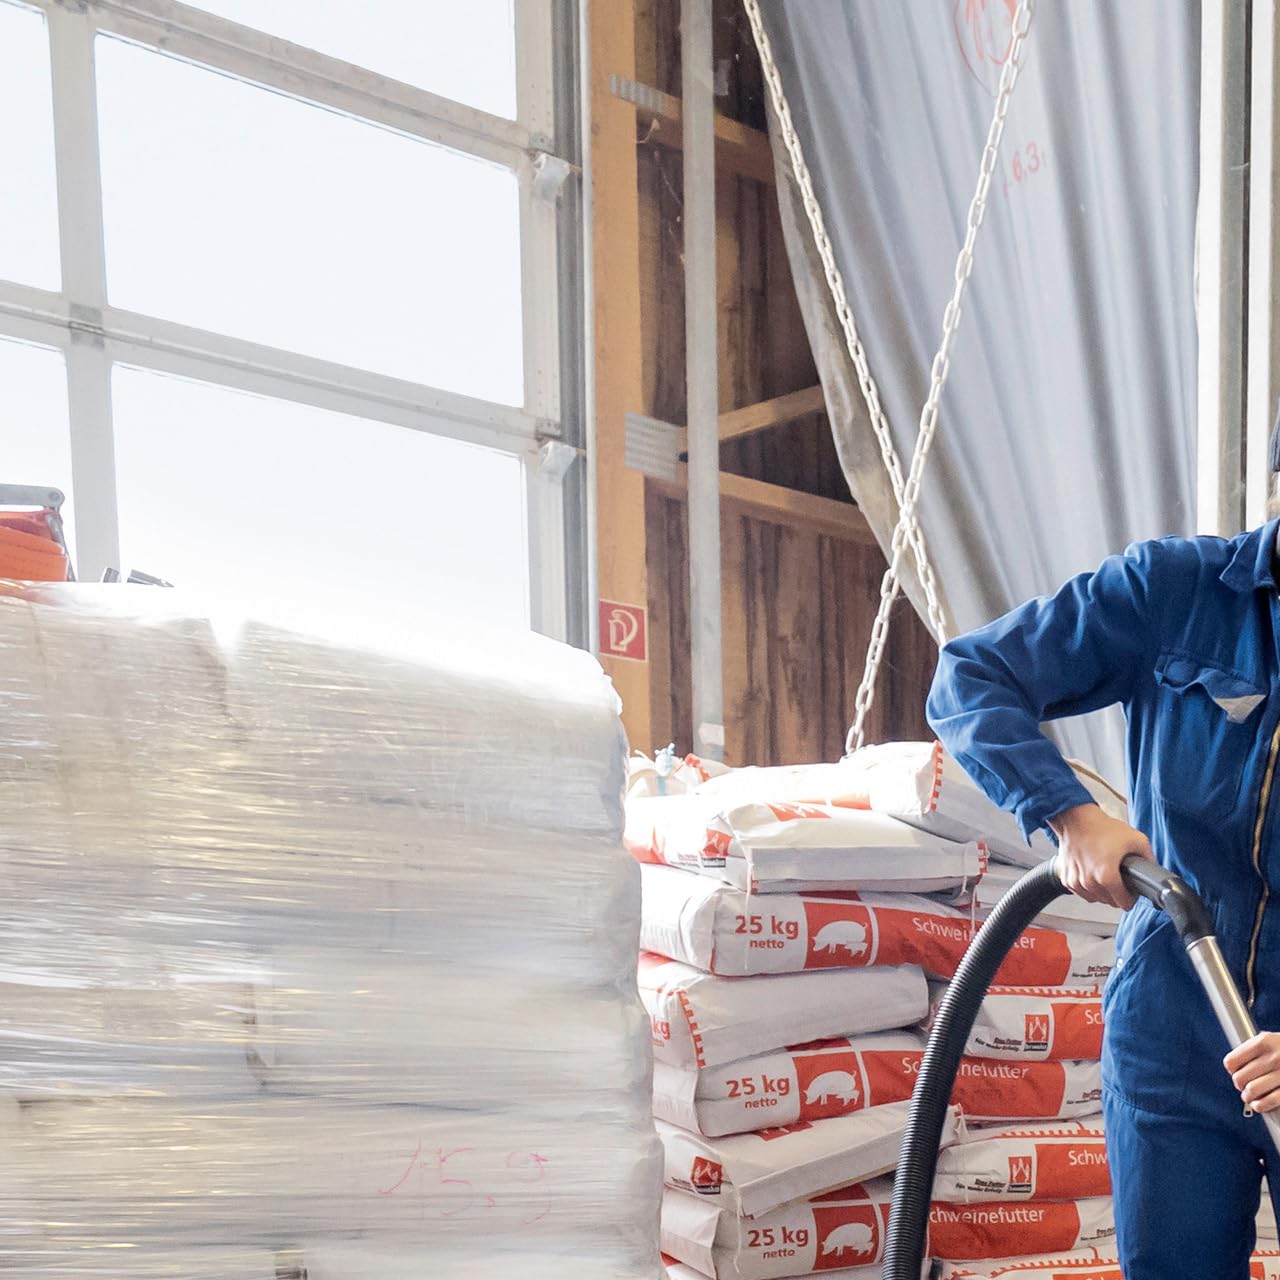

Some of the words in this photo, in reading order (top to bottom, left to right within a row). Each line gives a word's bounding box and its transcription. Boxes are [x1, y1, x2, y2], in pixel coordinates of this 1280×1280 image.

[734, 915, 763, 935] 25
[770, 916, 799, 939] kg
[911, 917, 1036, 949] Schweier
[749, 938, 785, 949] netto
[902, 1057, 1029, 1079] Scnefutter
[726, 1077, 756, 1098] 25
[763, 1074, 790, 1097] kg
[744, 1097, 778, 1109] netto
[929, 1206, 1044, 1224] chweinefutter
[747, 1228, 775, 1248] 25
[782, 1225, 809, 1249] kg
[762, 1248, 796, 1260] netto
